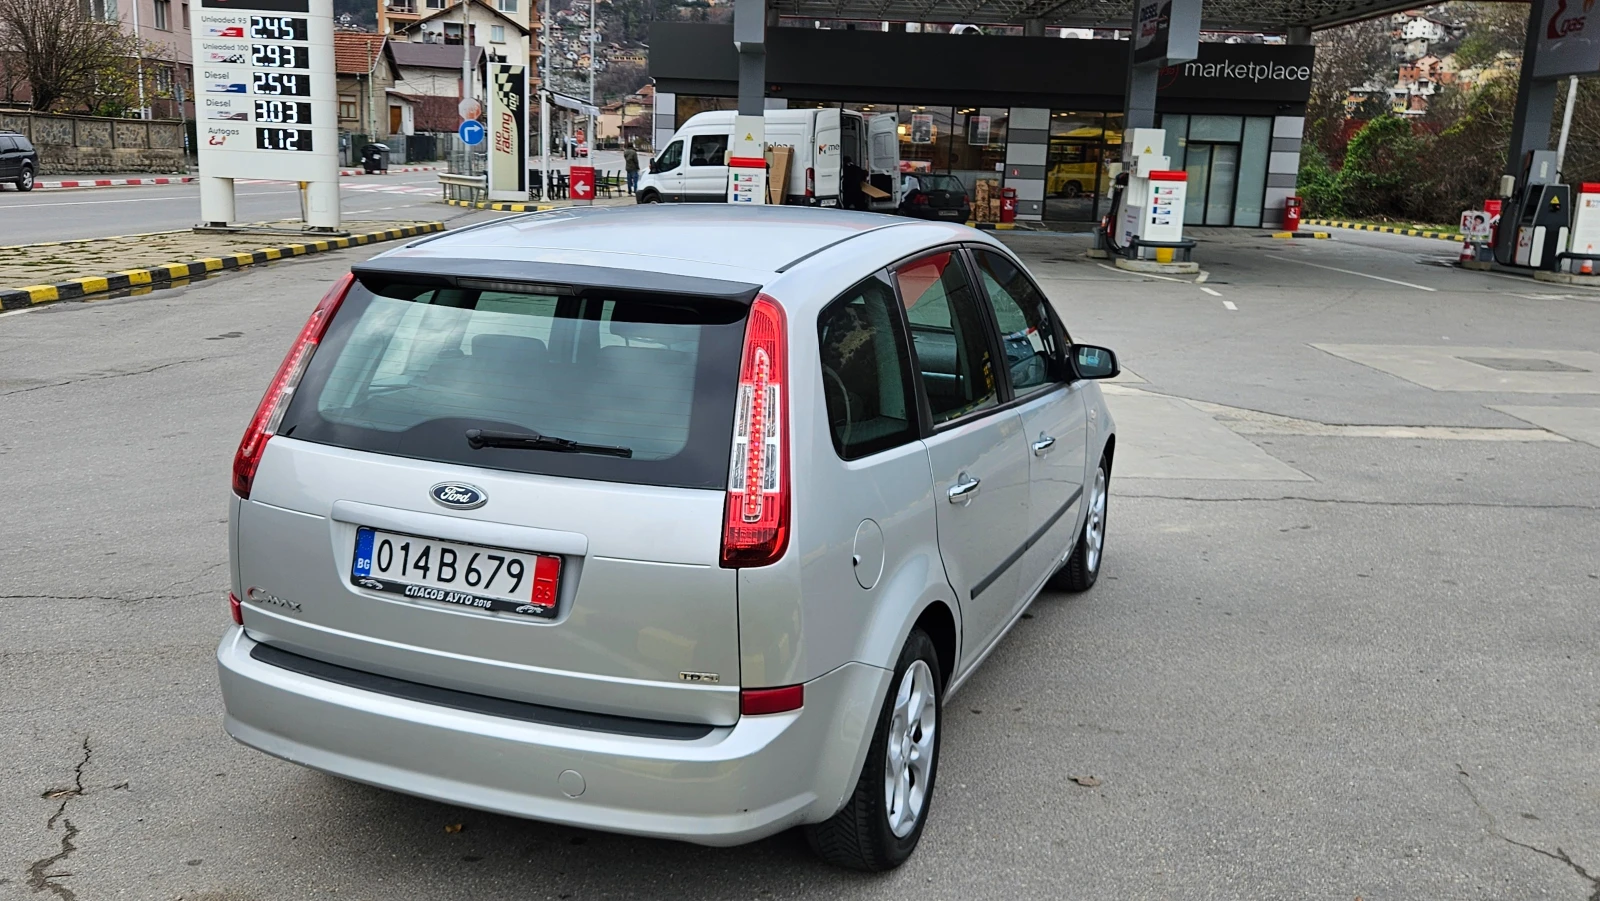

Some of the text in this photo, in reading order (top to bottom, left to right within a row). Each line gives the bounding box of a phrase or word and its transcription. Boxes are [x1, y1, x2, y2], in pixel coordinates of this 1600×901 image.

[201, 15, 247, 25] Unleaded 95
[251, 15, 295, 40] 2.45
[202, 43, 249, 52] Unleaded 100
[252, 44, 296, 68] 2.93
[204, 71, 230, 80] Diesel
[1184, 59, 1311, 84] marketplace
[253, 72, 297, 95] 2.54
[206, 99, 231, 108] Diesel
[255, 100, 298, 123] 3.03
[508, 92, 517, 111] 100
[208, 127, 240, 136] Autogas
[263, 128, 299, 151] 1.12
[502, 112, 513, 154] racing
[440, 486, 472, 503] Ford
[356, 557, 370, 570] BG
[377, 538, 525, 594] 014B679
[404, 585, 493, 609] СПАСОВ АУТО 2016
